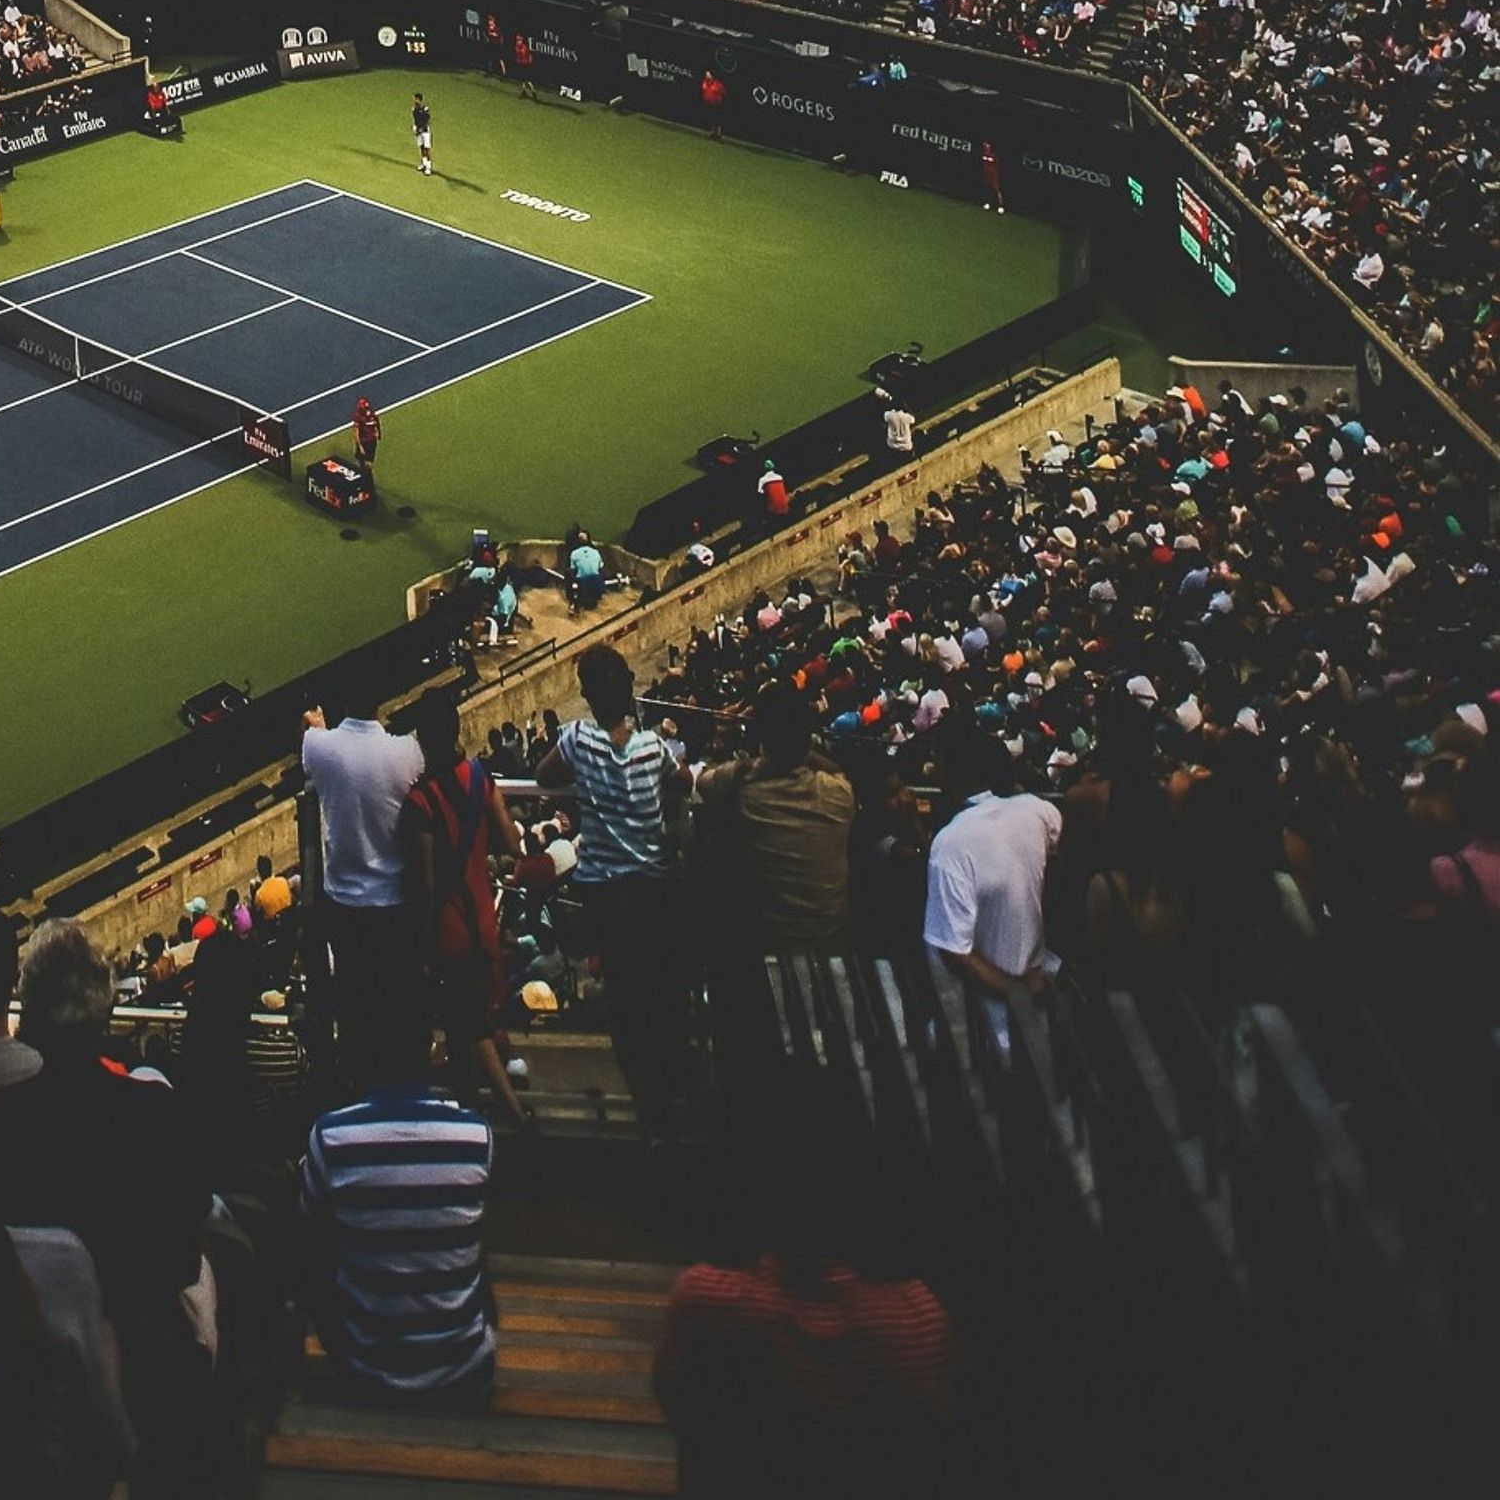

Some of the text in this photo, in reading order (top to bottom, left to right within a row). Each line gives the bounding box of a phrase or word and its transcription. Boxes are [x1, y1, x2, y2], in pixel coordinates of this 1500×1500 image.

[306, 49, 347, 67] AVIVA
[528, 36, 579, 63] Emirates
[559, 85, 582, 101] FILA
[771, 91, 836, 121] ROGERS
[62, 116, 106, 139] Emirates
[879, 170, 909, 188] FILA
[500, 188, 592, 223] TORONTO
[19, 337, 45, 356] ATP
[103, 375, 144, 405] TOUR
